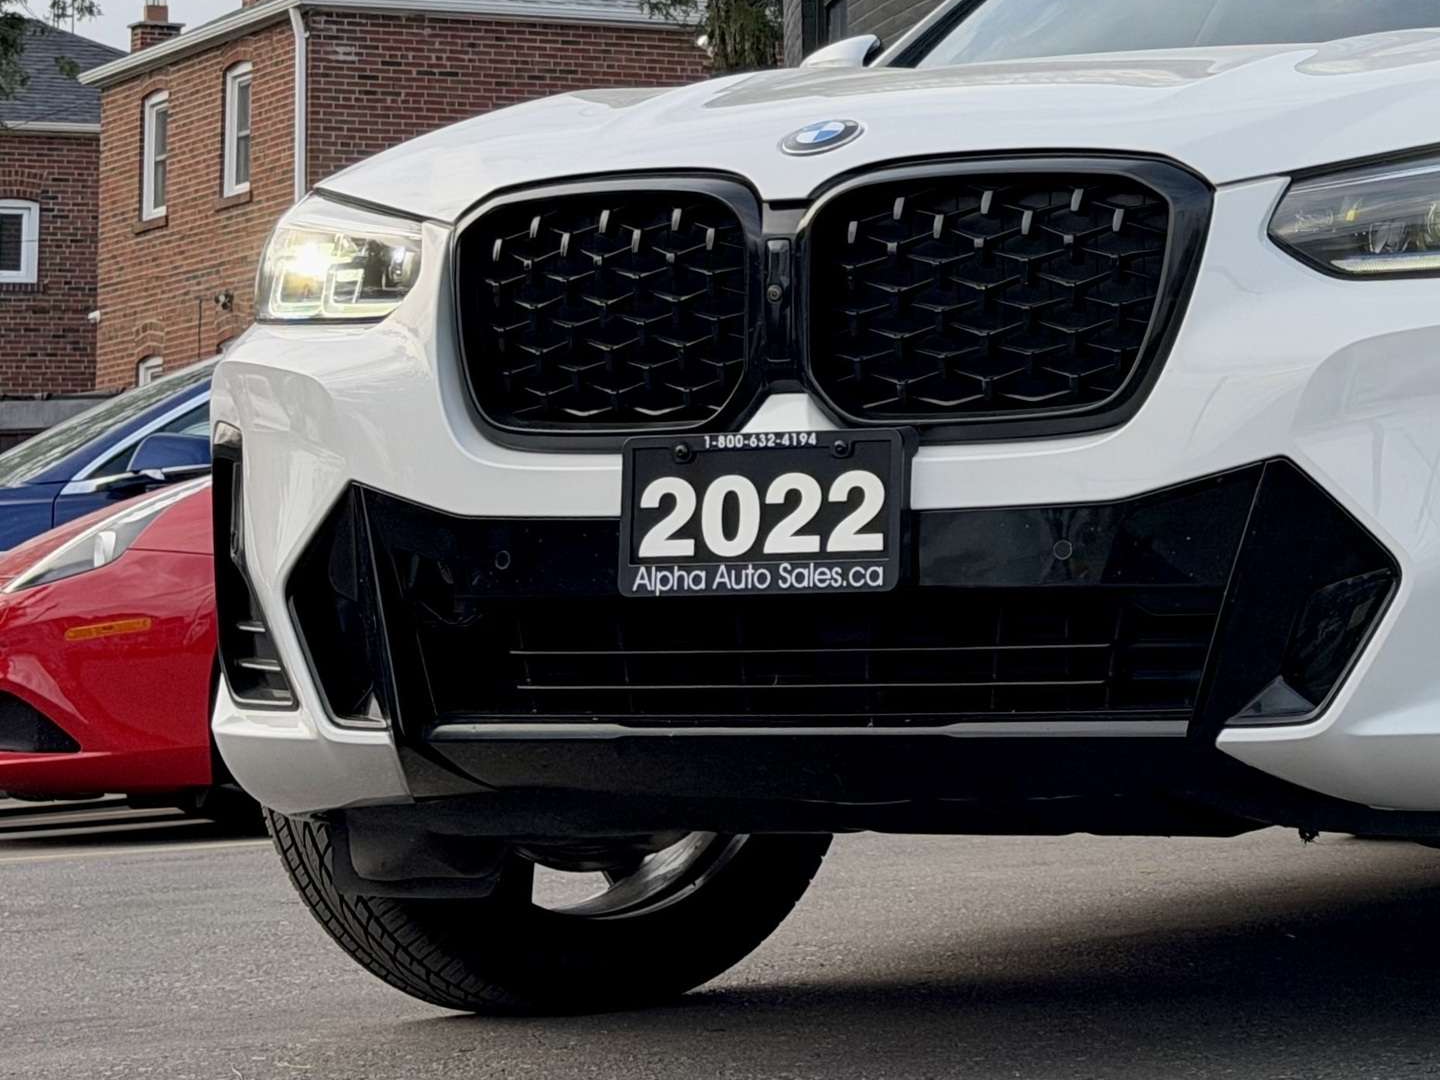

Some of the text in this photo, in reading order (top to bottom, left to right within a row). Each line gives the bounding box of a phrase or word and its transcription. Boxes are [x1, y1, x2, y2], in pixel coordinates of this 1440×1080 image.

[704, 431, 817, 449] 1-800-632-4194
[638, 469, 885, 558] 2022
[632, 562, 884, 597] Alpha Auto Sales.ca
